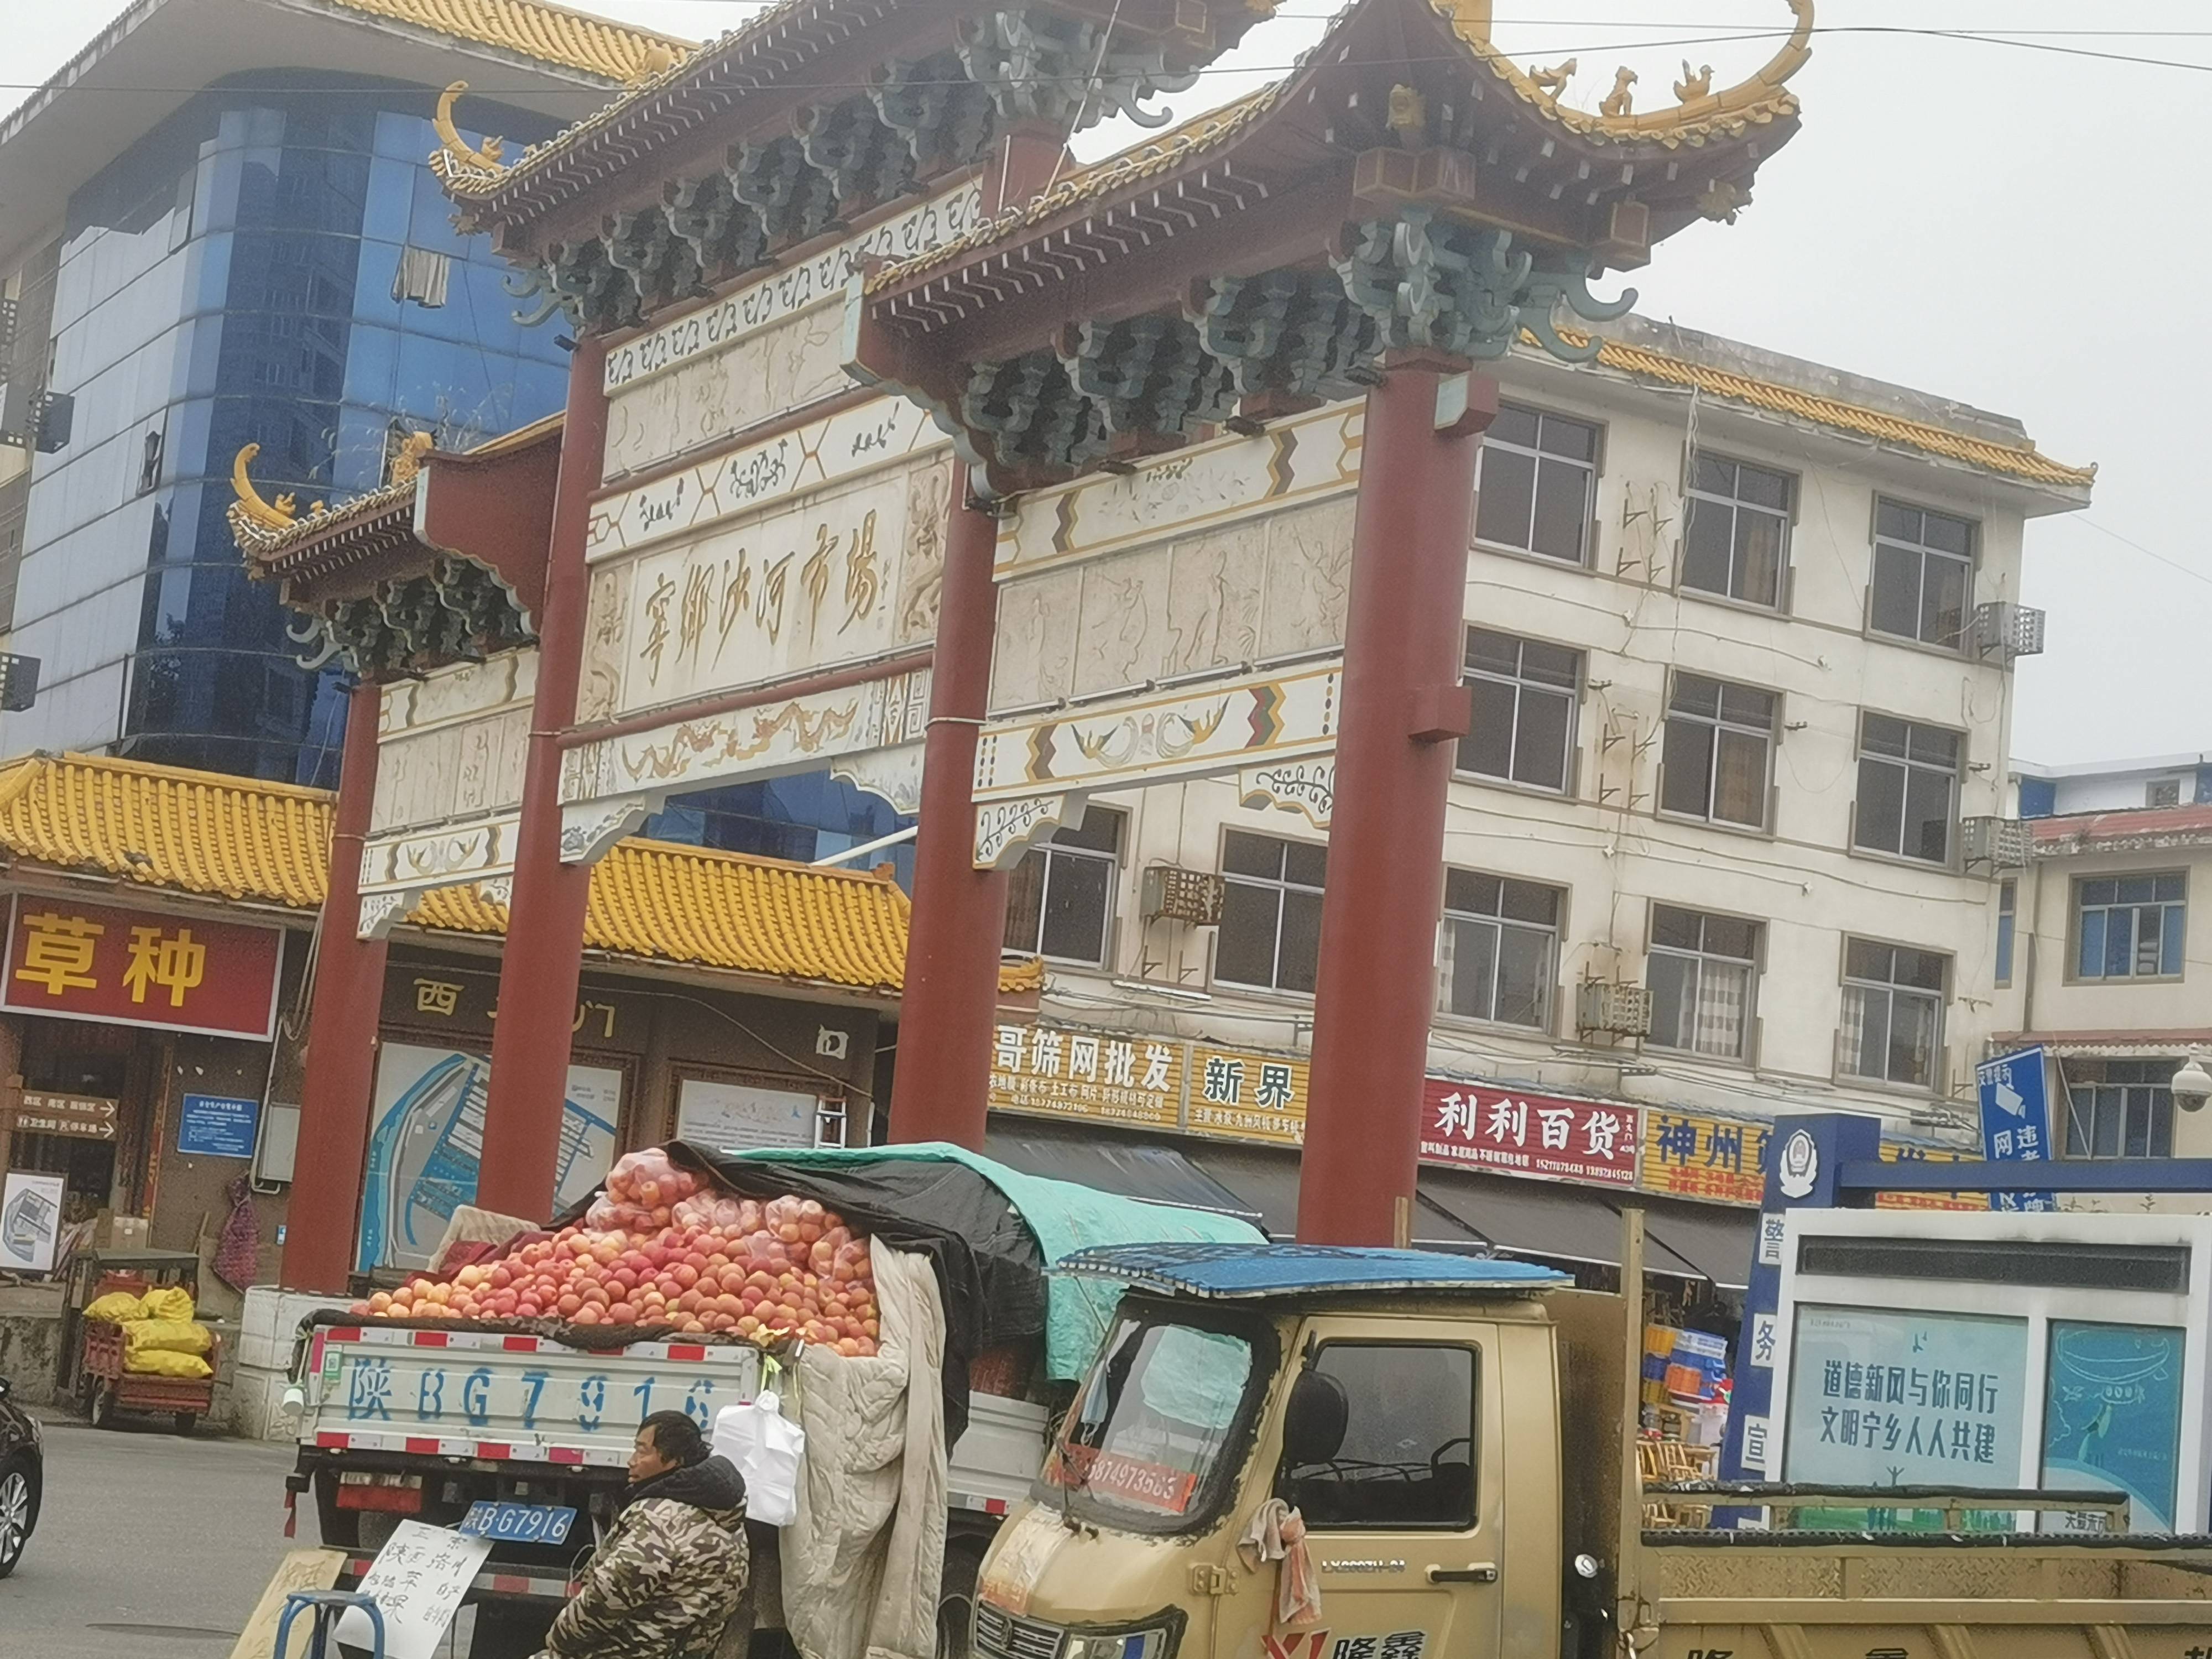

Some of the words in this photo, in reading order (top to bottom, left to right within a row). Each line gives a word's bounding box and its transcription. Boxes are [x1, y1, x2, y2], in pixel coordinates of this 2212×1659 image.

[15, 912, 206, 1007] 草种
[413, 978, 615, 1037] 西门
[995, 1025, 1172, 1092] 哥筛网批发
[1204, 1056, 1296, 1110] 新界
[1435, 1092, 1620, 1160] 利利百货
[1823, 1360, 1999, 1414] 道德新风与你同行
[1820, 1406, 1996, 1464] 文明宁乡人人共建
